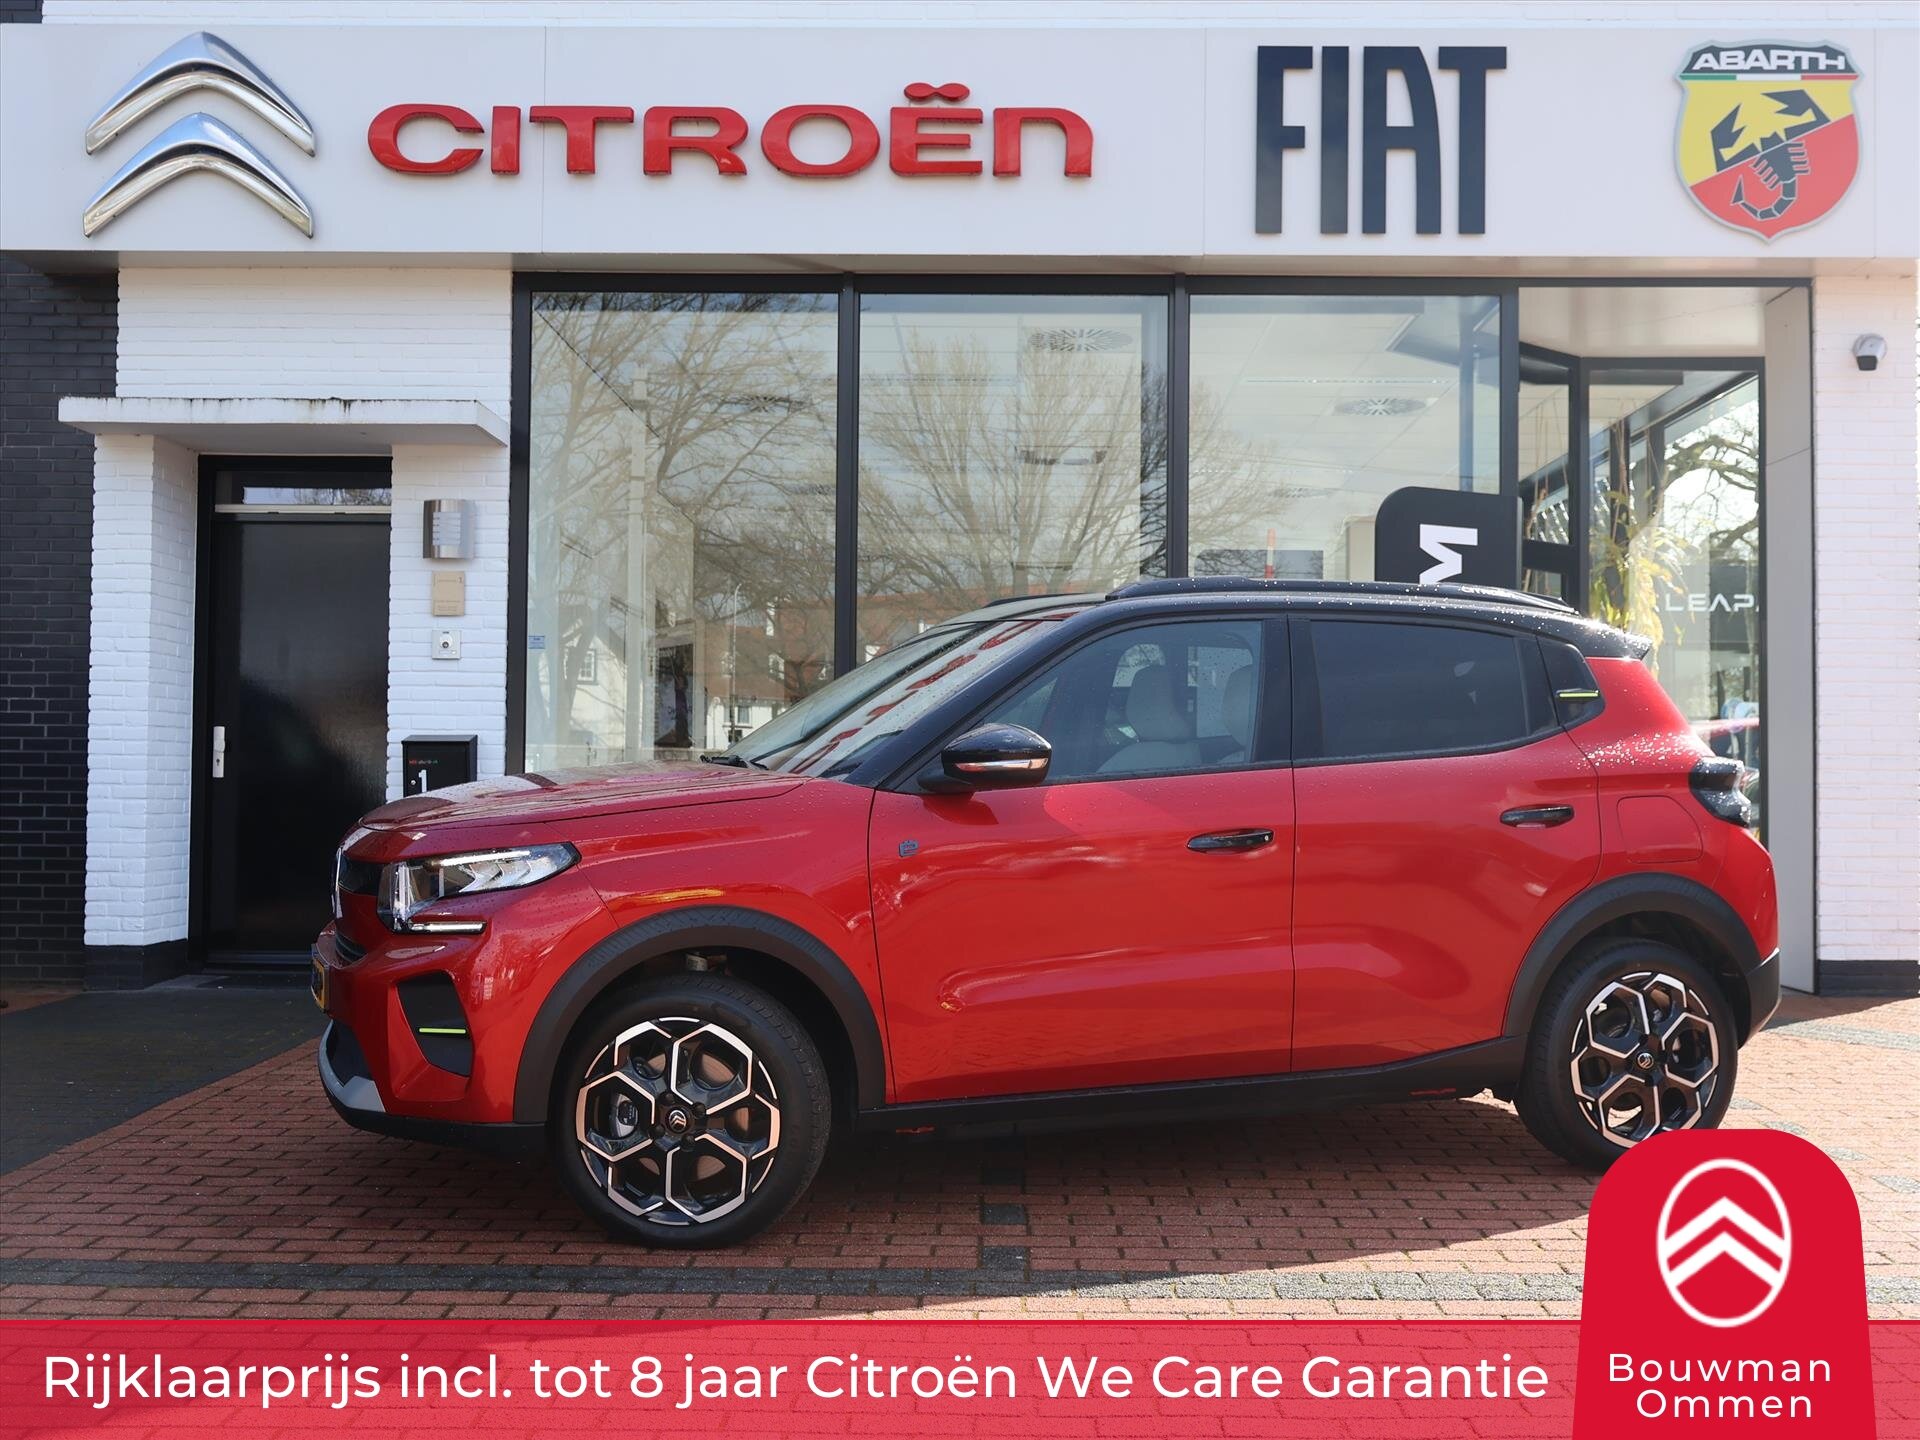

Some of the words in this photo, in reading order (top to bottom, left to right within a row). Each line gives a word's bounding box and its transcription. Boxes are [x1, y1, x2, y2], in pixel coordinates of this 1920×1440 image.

[1691, 48, 1846, 71] ABARTH
[1255, 45, 1507, 235] FIAT
[1665, 593, 1760, 612] LEAP
